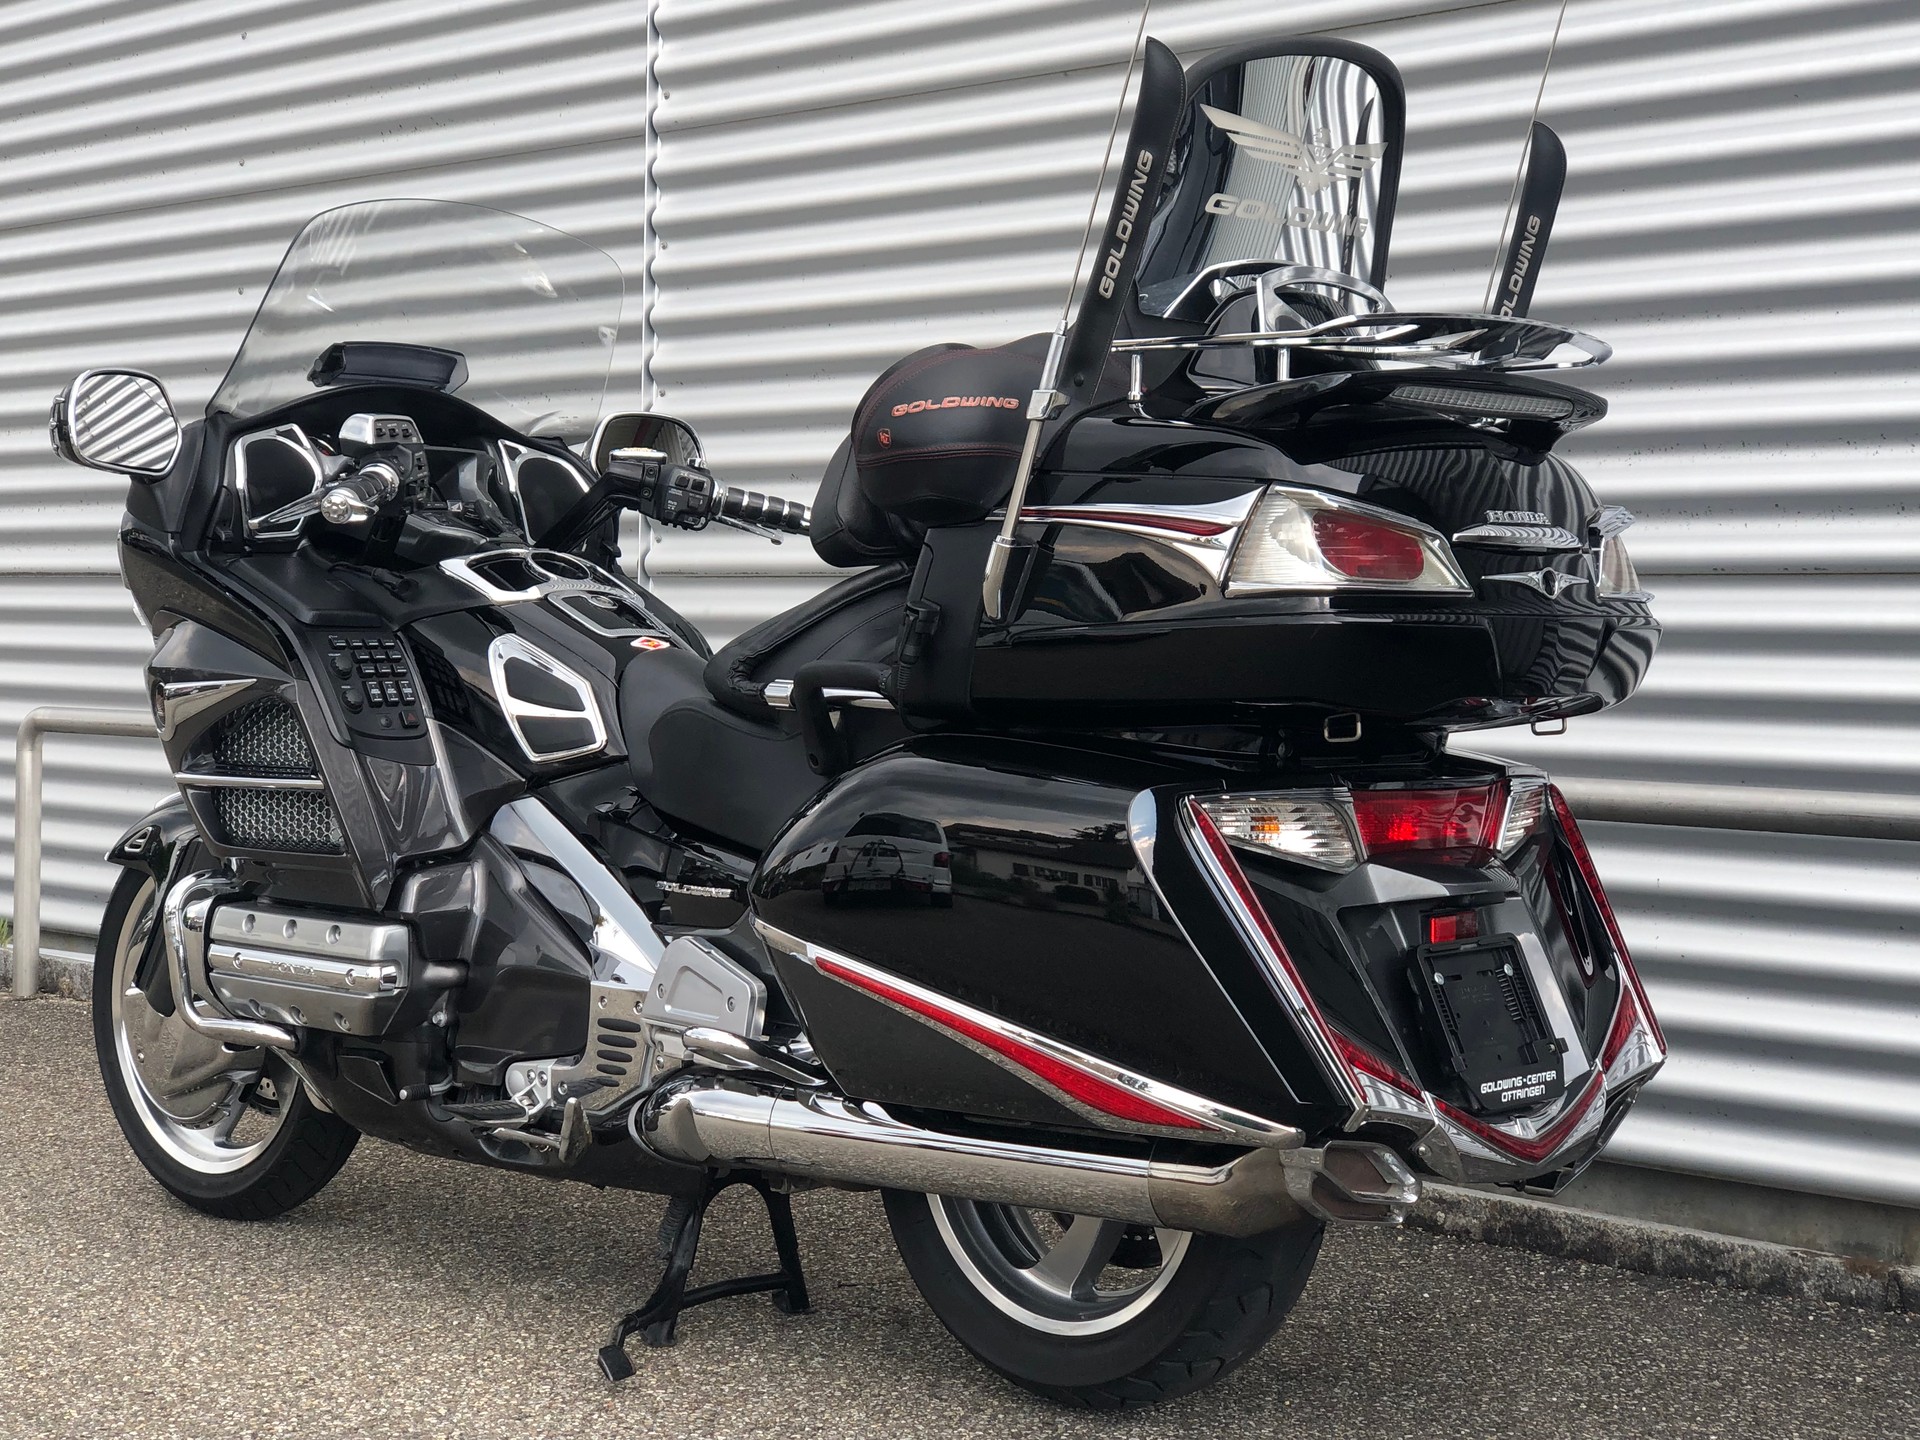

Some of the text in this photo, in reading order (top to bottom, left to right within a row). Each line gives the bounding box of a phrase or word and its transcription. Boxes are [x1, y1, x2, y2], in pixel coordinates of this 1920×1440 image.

[1099, 149, 1154, 300] GOLDWING
[1204, 192, 1369, 238] GOLDWING
[1499, 214, 1541, 318] OLDWING
[890, 395, 1020, 418] GOLDWING
[1484, 509, 1551, 525] HONDA
